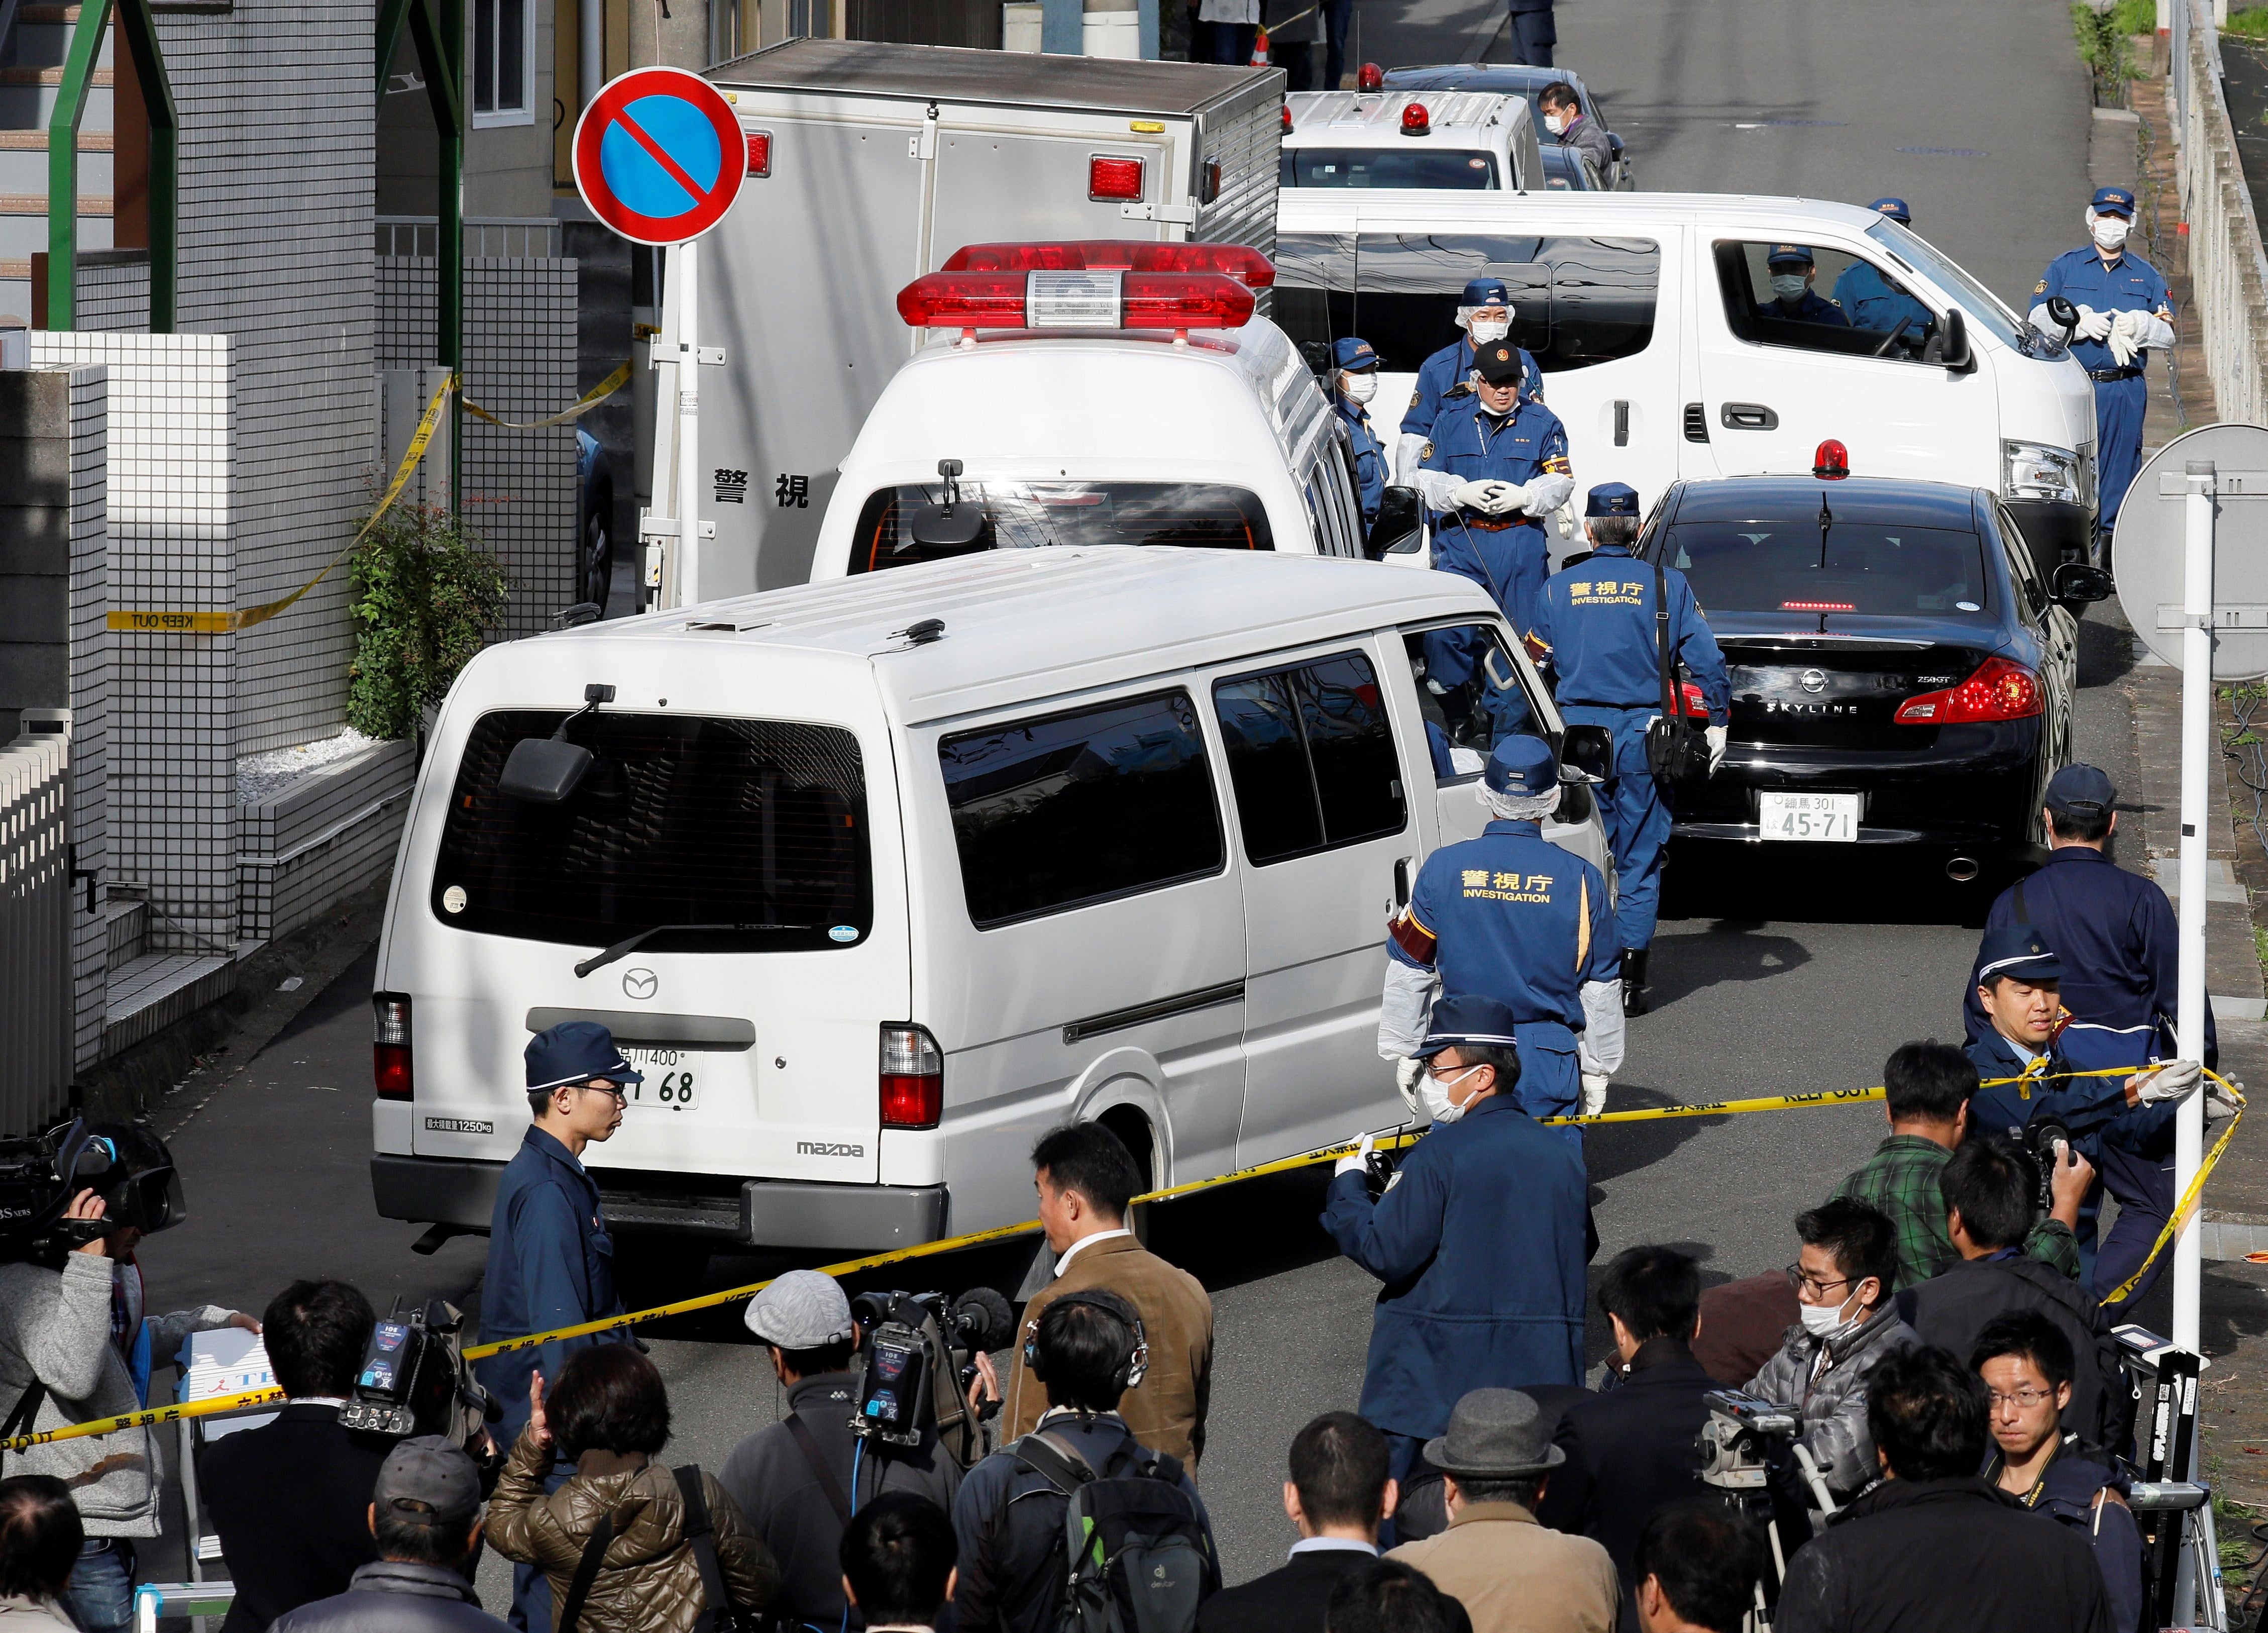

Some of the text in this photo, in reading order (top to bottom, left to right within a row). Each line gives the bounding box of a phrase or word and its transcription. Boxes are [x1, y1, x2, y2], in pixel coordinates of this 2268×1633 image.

[713, 469, 809, 508] 警視
[1570, 581, 1644, 597] 警視庁
[1571, 596, 1642, 606] INVESTIGATION
[1766, 703, 1857, 713] SKYLINE
[1784, 797, 1834, 810] 練馬 301
[1782, 812, 1848, 837] 45-71
[1461, 870, 1553, 892] 警視庁
[1463, 889, 1550, 903] INVESTIGATION
[2028, 1482, 2044, 1507] Nikon
